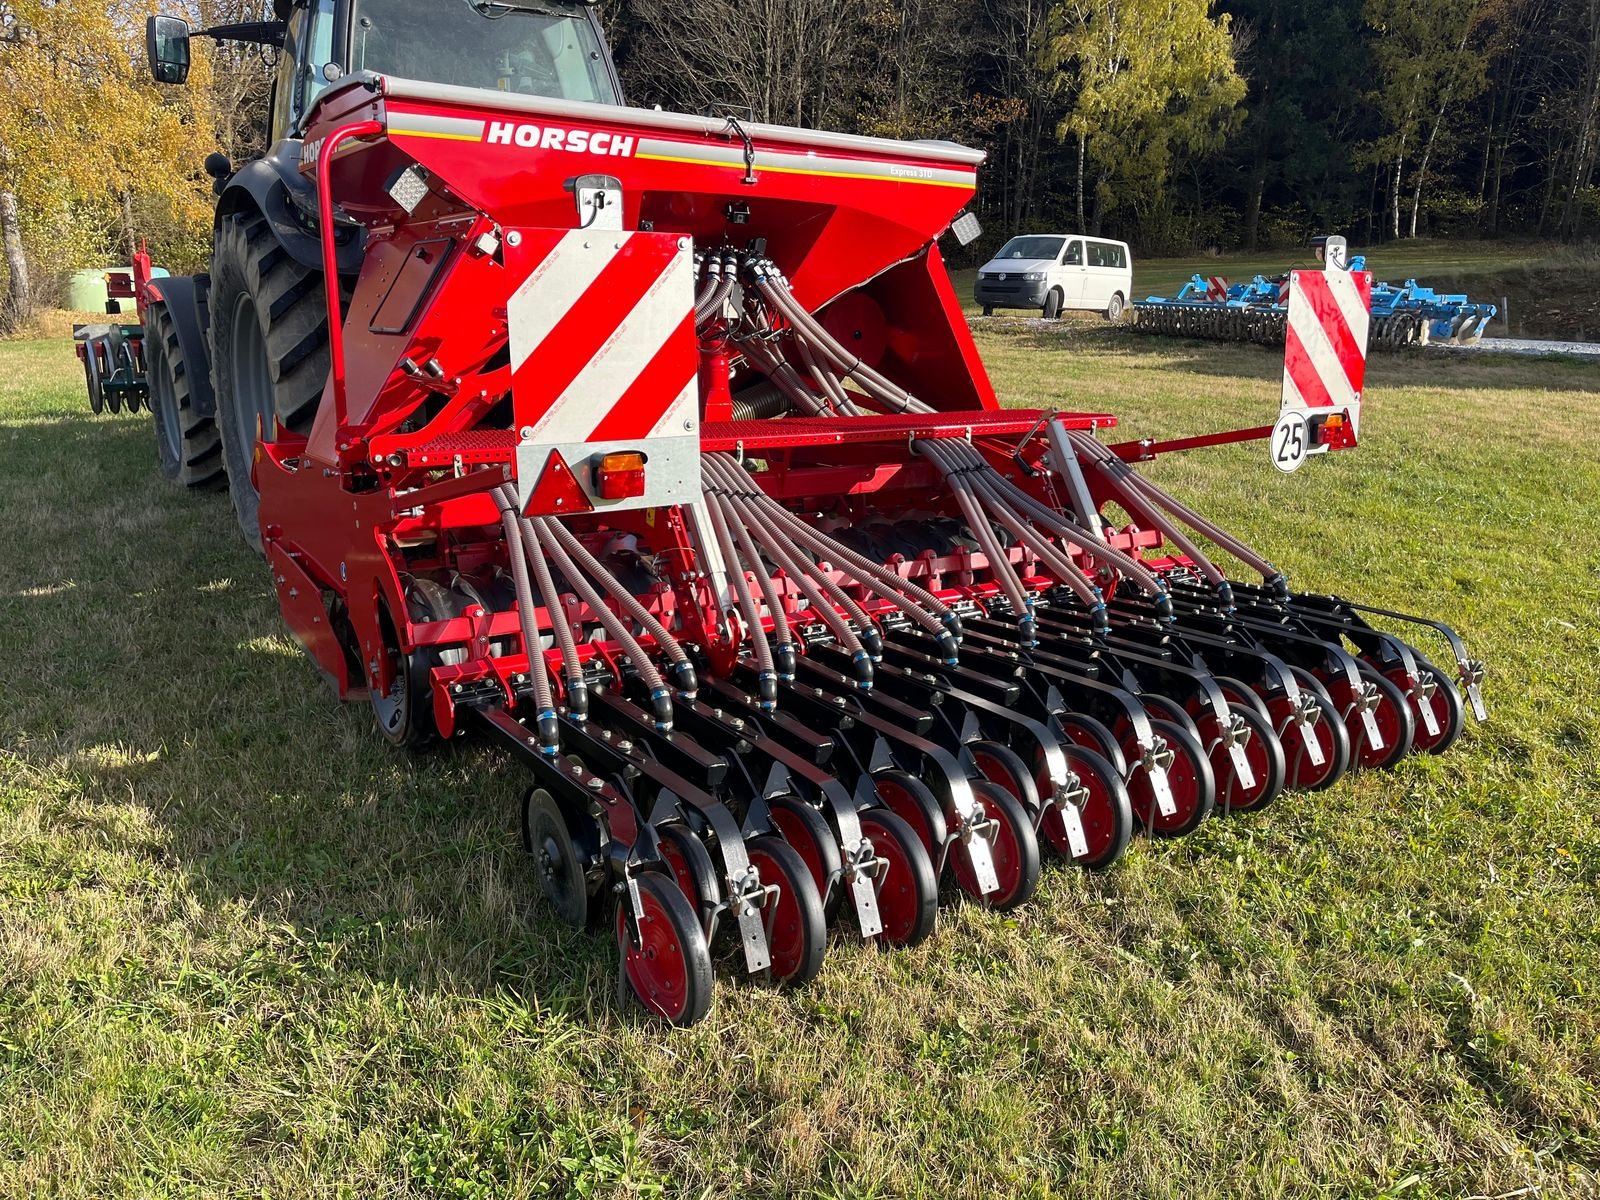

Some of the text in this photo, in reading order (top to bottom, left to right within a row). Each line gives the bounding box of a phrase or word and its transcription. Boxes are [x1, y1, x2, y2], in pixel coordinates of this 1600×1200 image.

[303, 137, 338, 164] HOR
[487, 121, 634, 157] HORSCH
[890, 166, 917, 177] Express
[1277, 422, 1303, 462] 25
